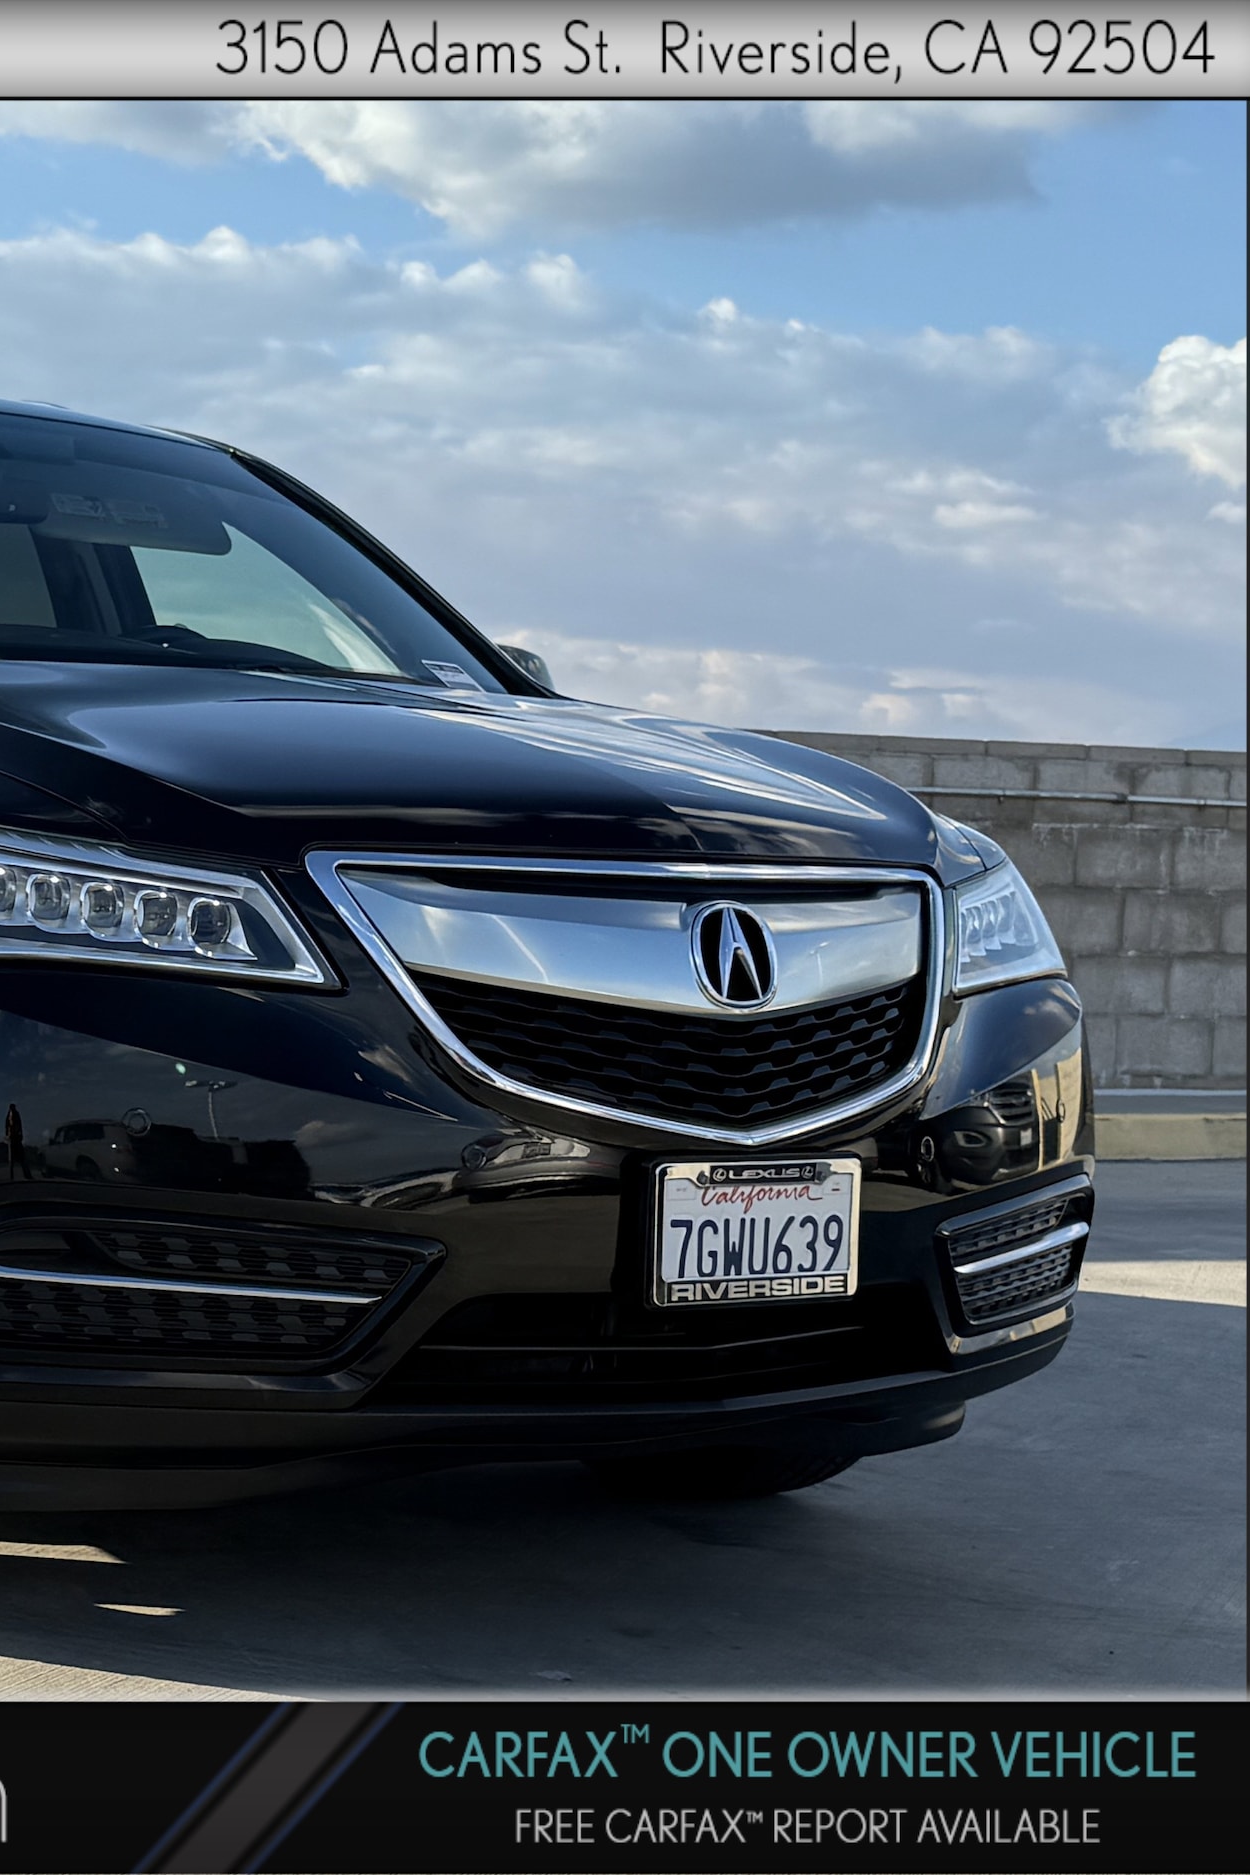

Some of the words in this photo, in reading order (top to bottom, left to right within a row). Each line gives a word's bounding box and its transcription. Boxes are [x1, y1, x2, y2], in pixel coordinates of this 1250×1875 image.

[729, 1168, 800, 1180] LEXUS
[702, 1185, 823, 1214] California
[670, 1215, 844, 1278] 7GWU639
[671, 1276, 845, 1302] RIVERSIDE
